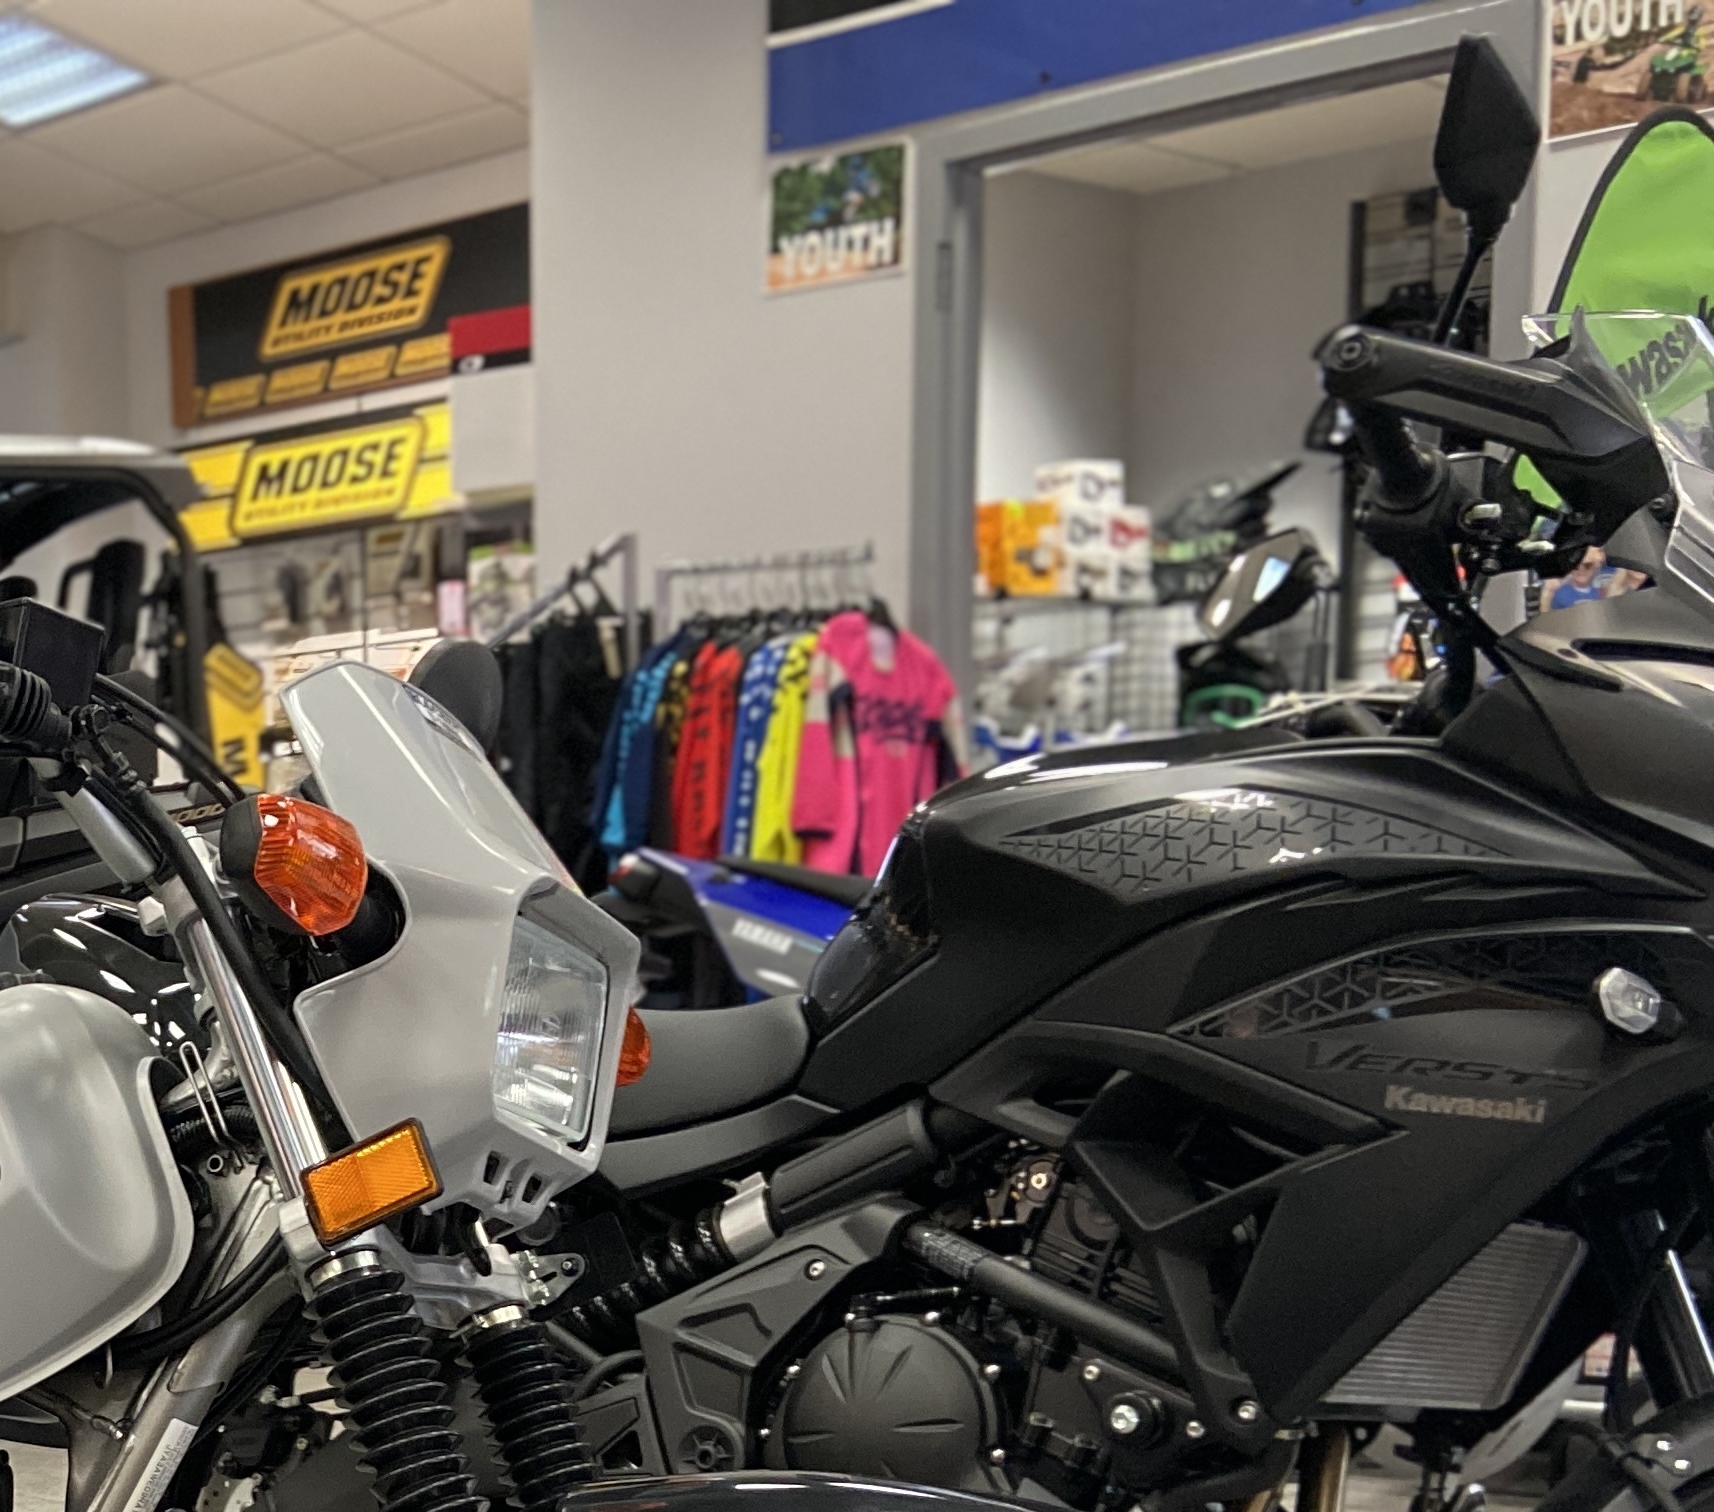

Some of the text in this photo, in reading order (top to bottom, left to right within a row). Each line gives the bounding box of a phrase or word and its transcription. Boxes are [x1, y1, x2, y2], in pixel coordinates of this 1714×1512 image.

[1561, 0, 1684, 46] YOUTH
[780, 217, 895, 279] YOUTH
[279, 252, 435, 328] MOOSE
[271, 306, 419, 349] UTILITY DIVISION
[251, 436, 406, 502] MOOSE
[1385, 1084, 1546, 1123] Kawasaki
